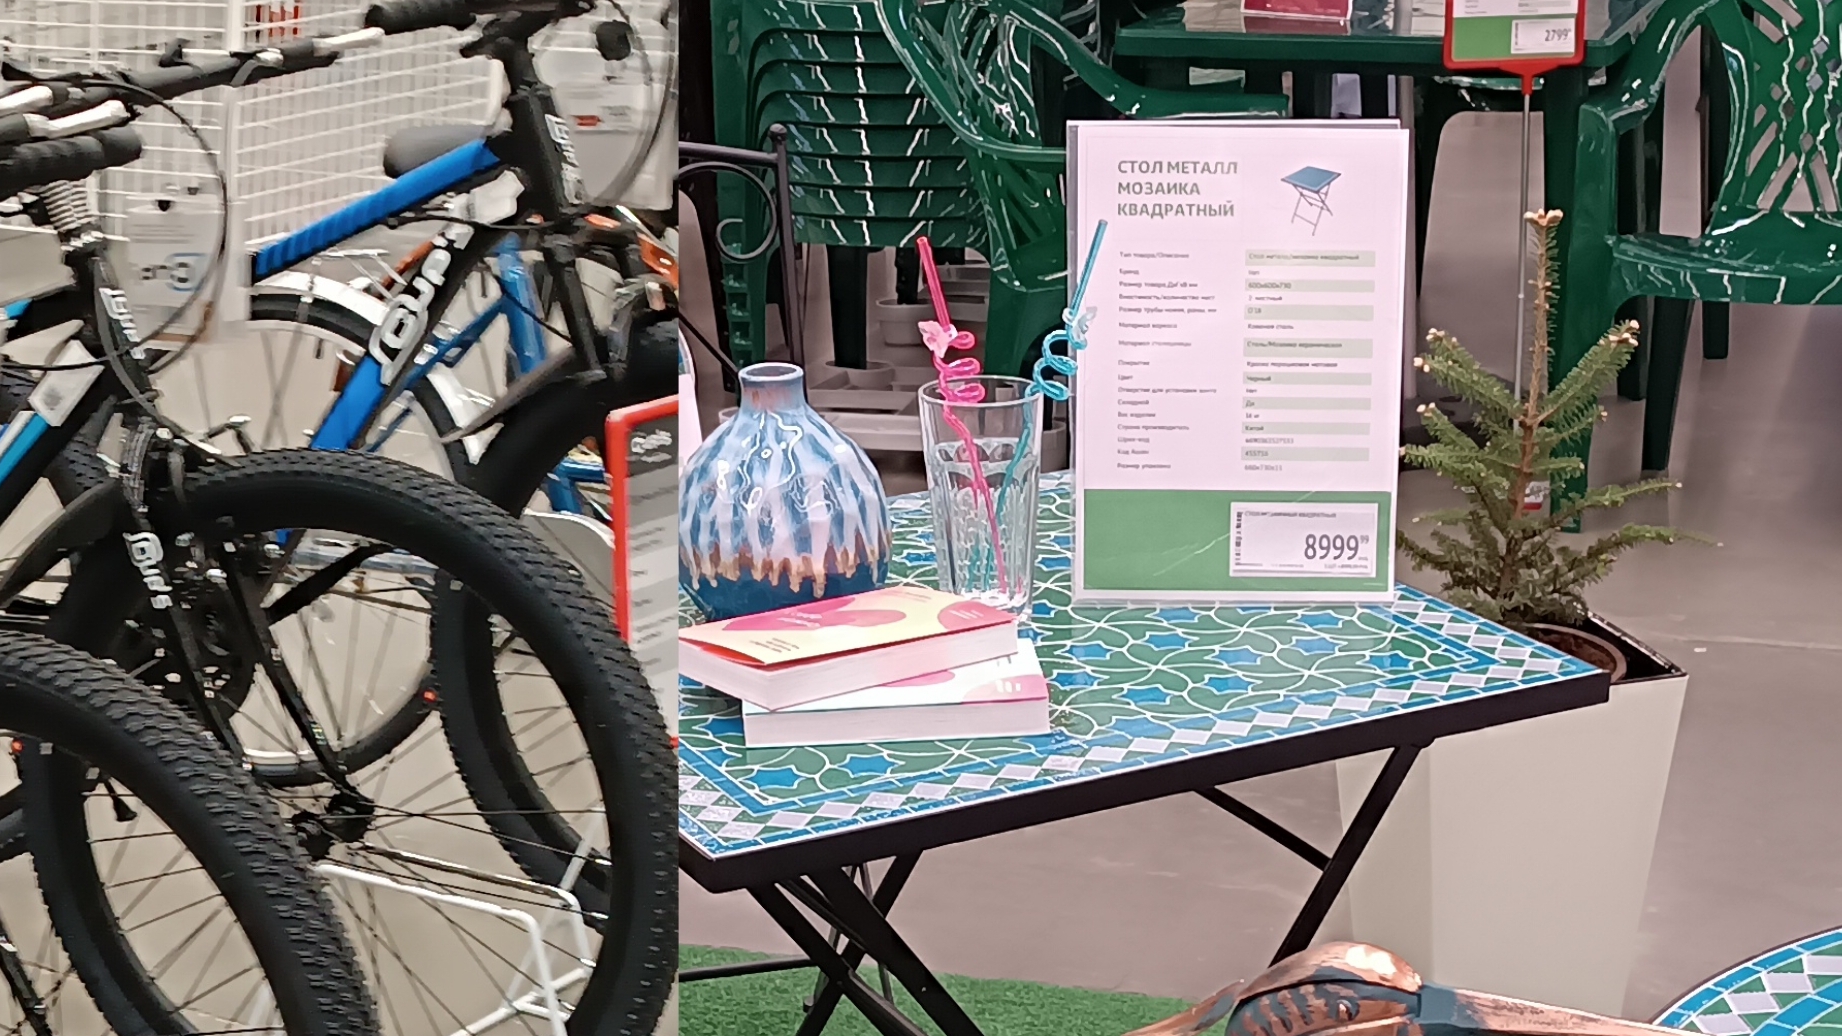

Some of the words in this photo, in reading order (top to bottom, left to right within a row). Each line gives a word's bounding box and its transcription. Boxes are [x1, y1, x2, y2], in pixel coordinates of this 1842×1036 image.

[1117, 160, 1163, 174] СТОЛ
[1167, 160, 1238, 175] МЕТАЛЛ
[1117, 181, 1201, 195] МОЗАИКА
[1117, 200, 1235, 219] КВАДРАТНЫЙ
[1304, 533, 1359, 561] 8999
